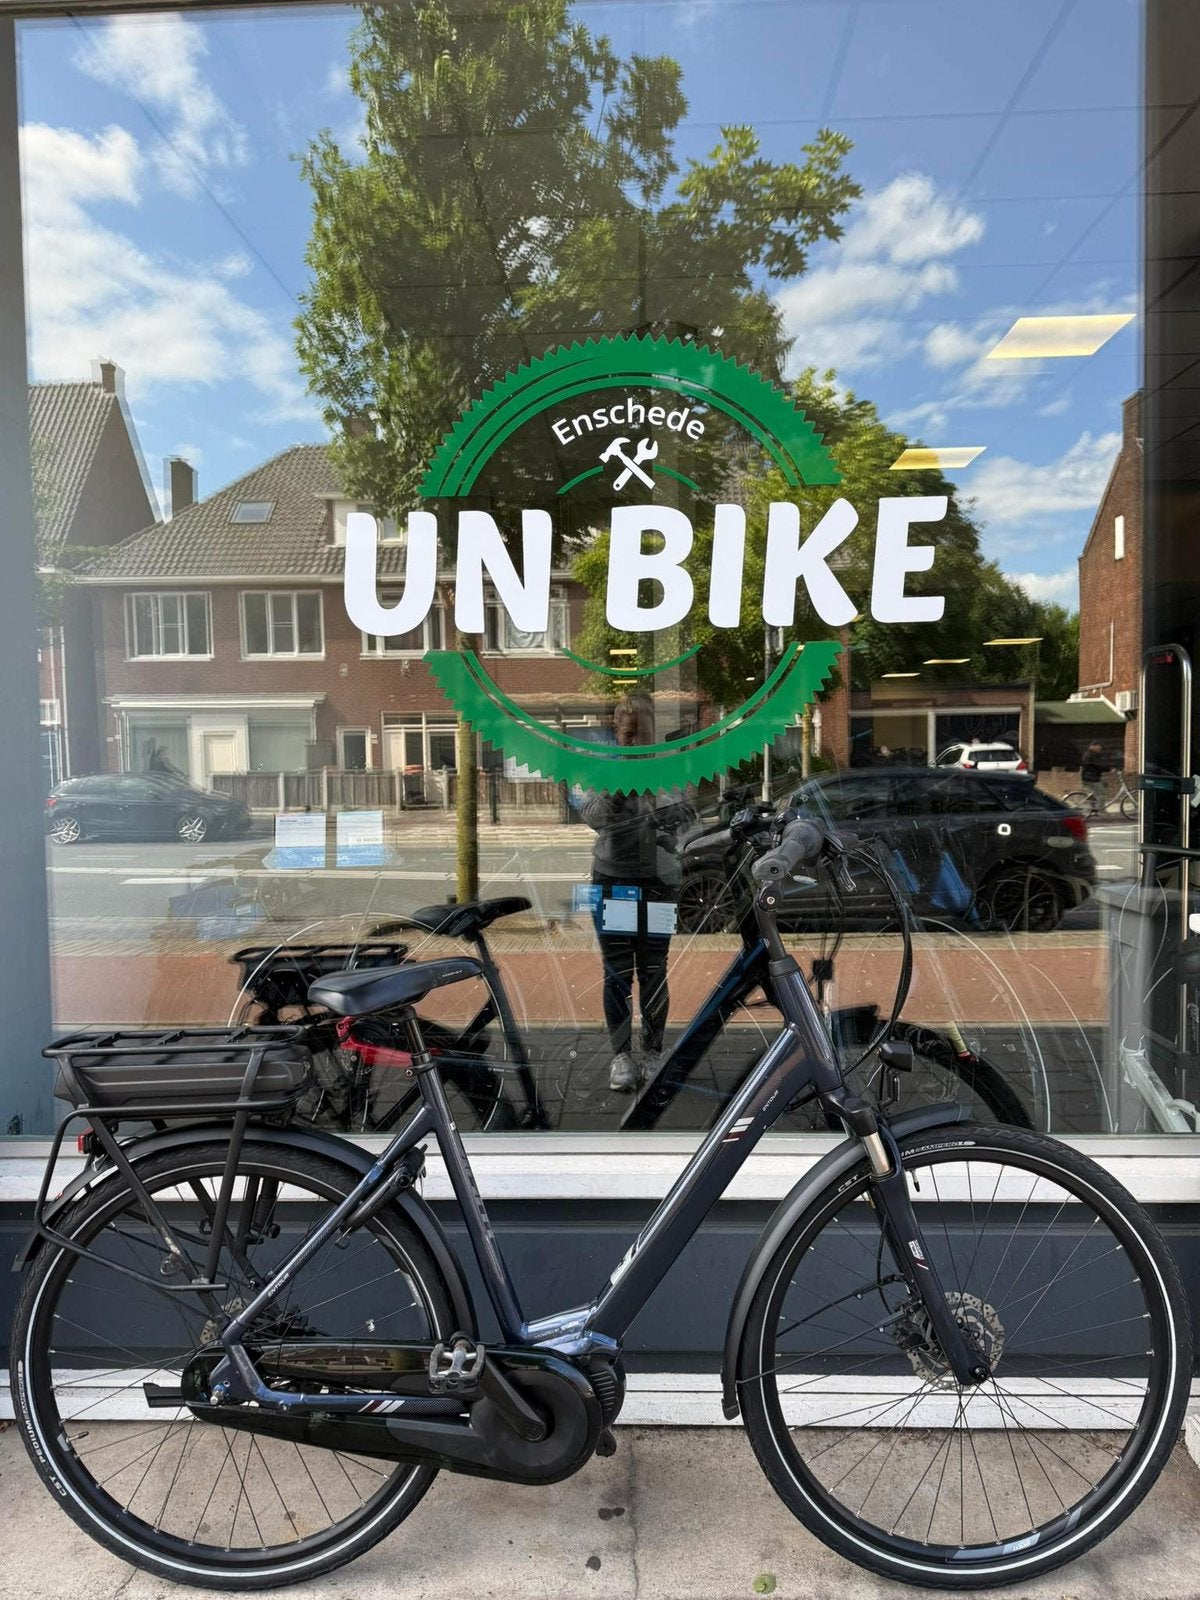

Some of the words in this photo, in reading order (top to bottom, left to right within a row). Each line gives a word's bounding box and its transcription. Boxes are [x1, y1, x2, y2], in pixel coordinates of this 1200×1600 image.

[551, 397, 705, 446] Enschede
[344, 509, 552, 637] UN
[606, 495, 948, 632] BIKE
[837, 1174, 859, 1192] CST
[49, 1475, 67, 1497] CST
